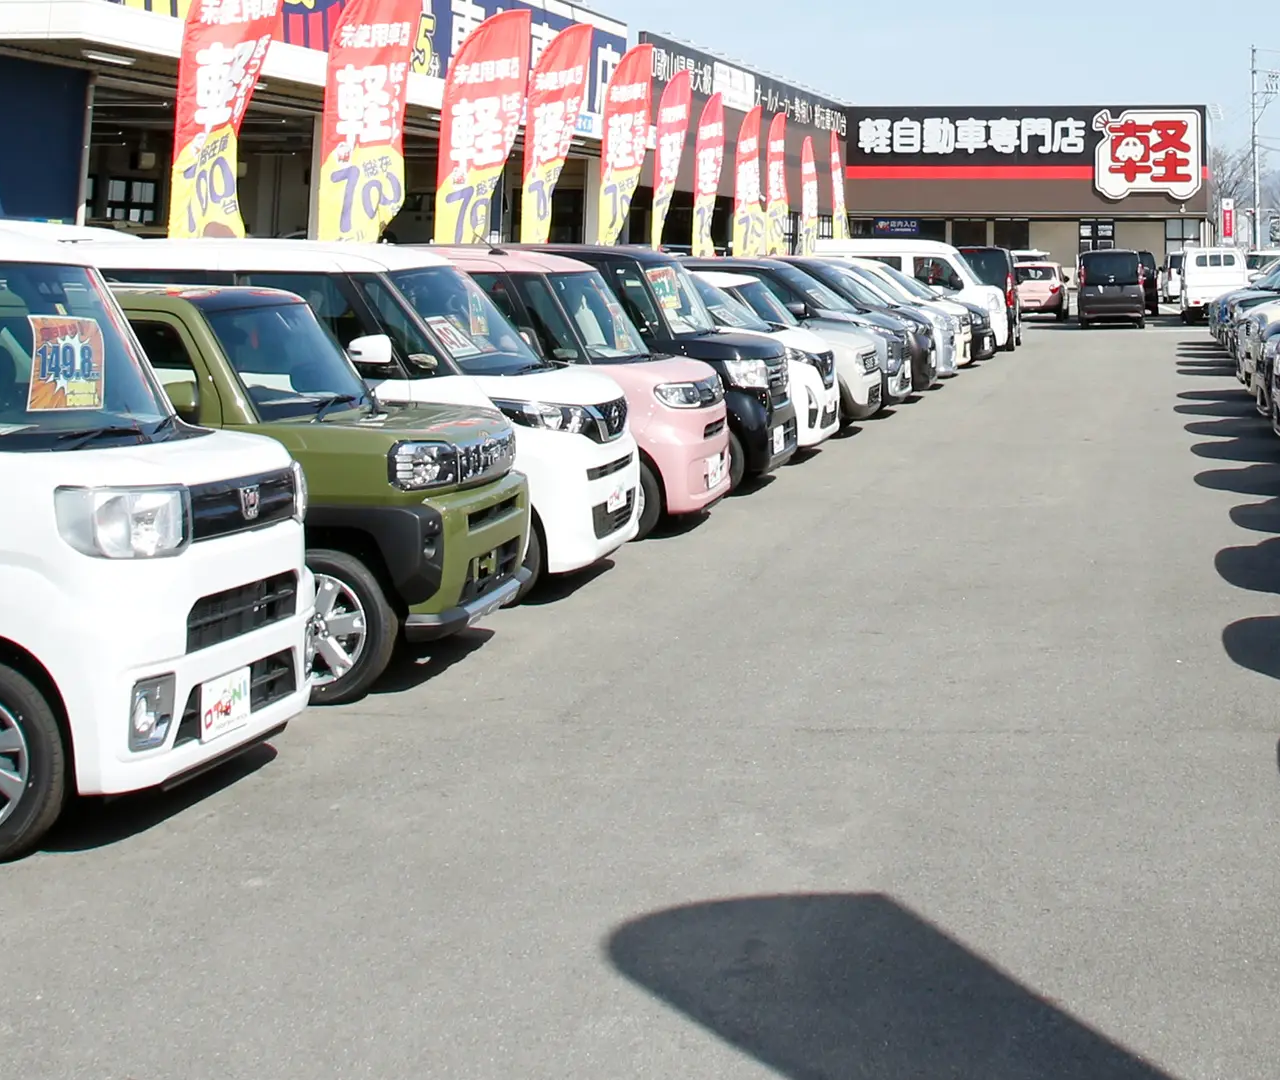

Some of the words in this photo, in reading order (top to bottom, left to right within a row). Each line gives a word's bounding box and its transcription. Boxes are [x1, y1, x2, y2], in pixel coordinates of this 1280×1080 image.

[335, 63, 392, 145] 軽
[450, 96, 505, 168] 軽
[857, 116, 1086, 155] 軽自動車専門店
[1108, 119, 1192, 183] 軽
[36, 343, 93, 380] 149.8
[204, 680, 247, 730] OTNI
